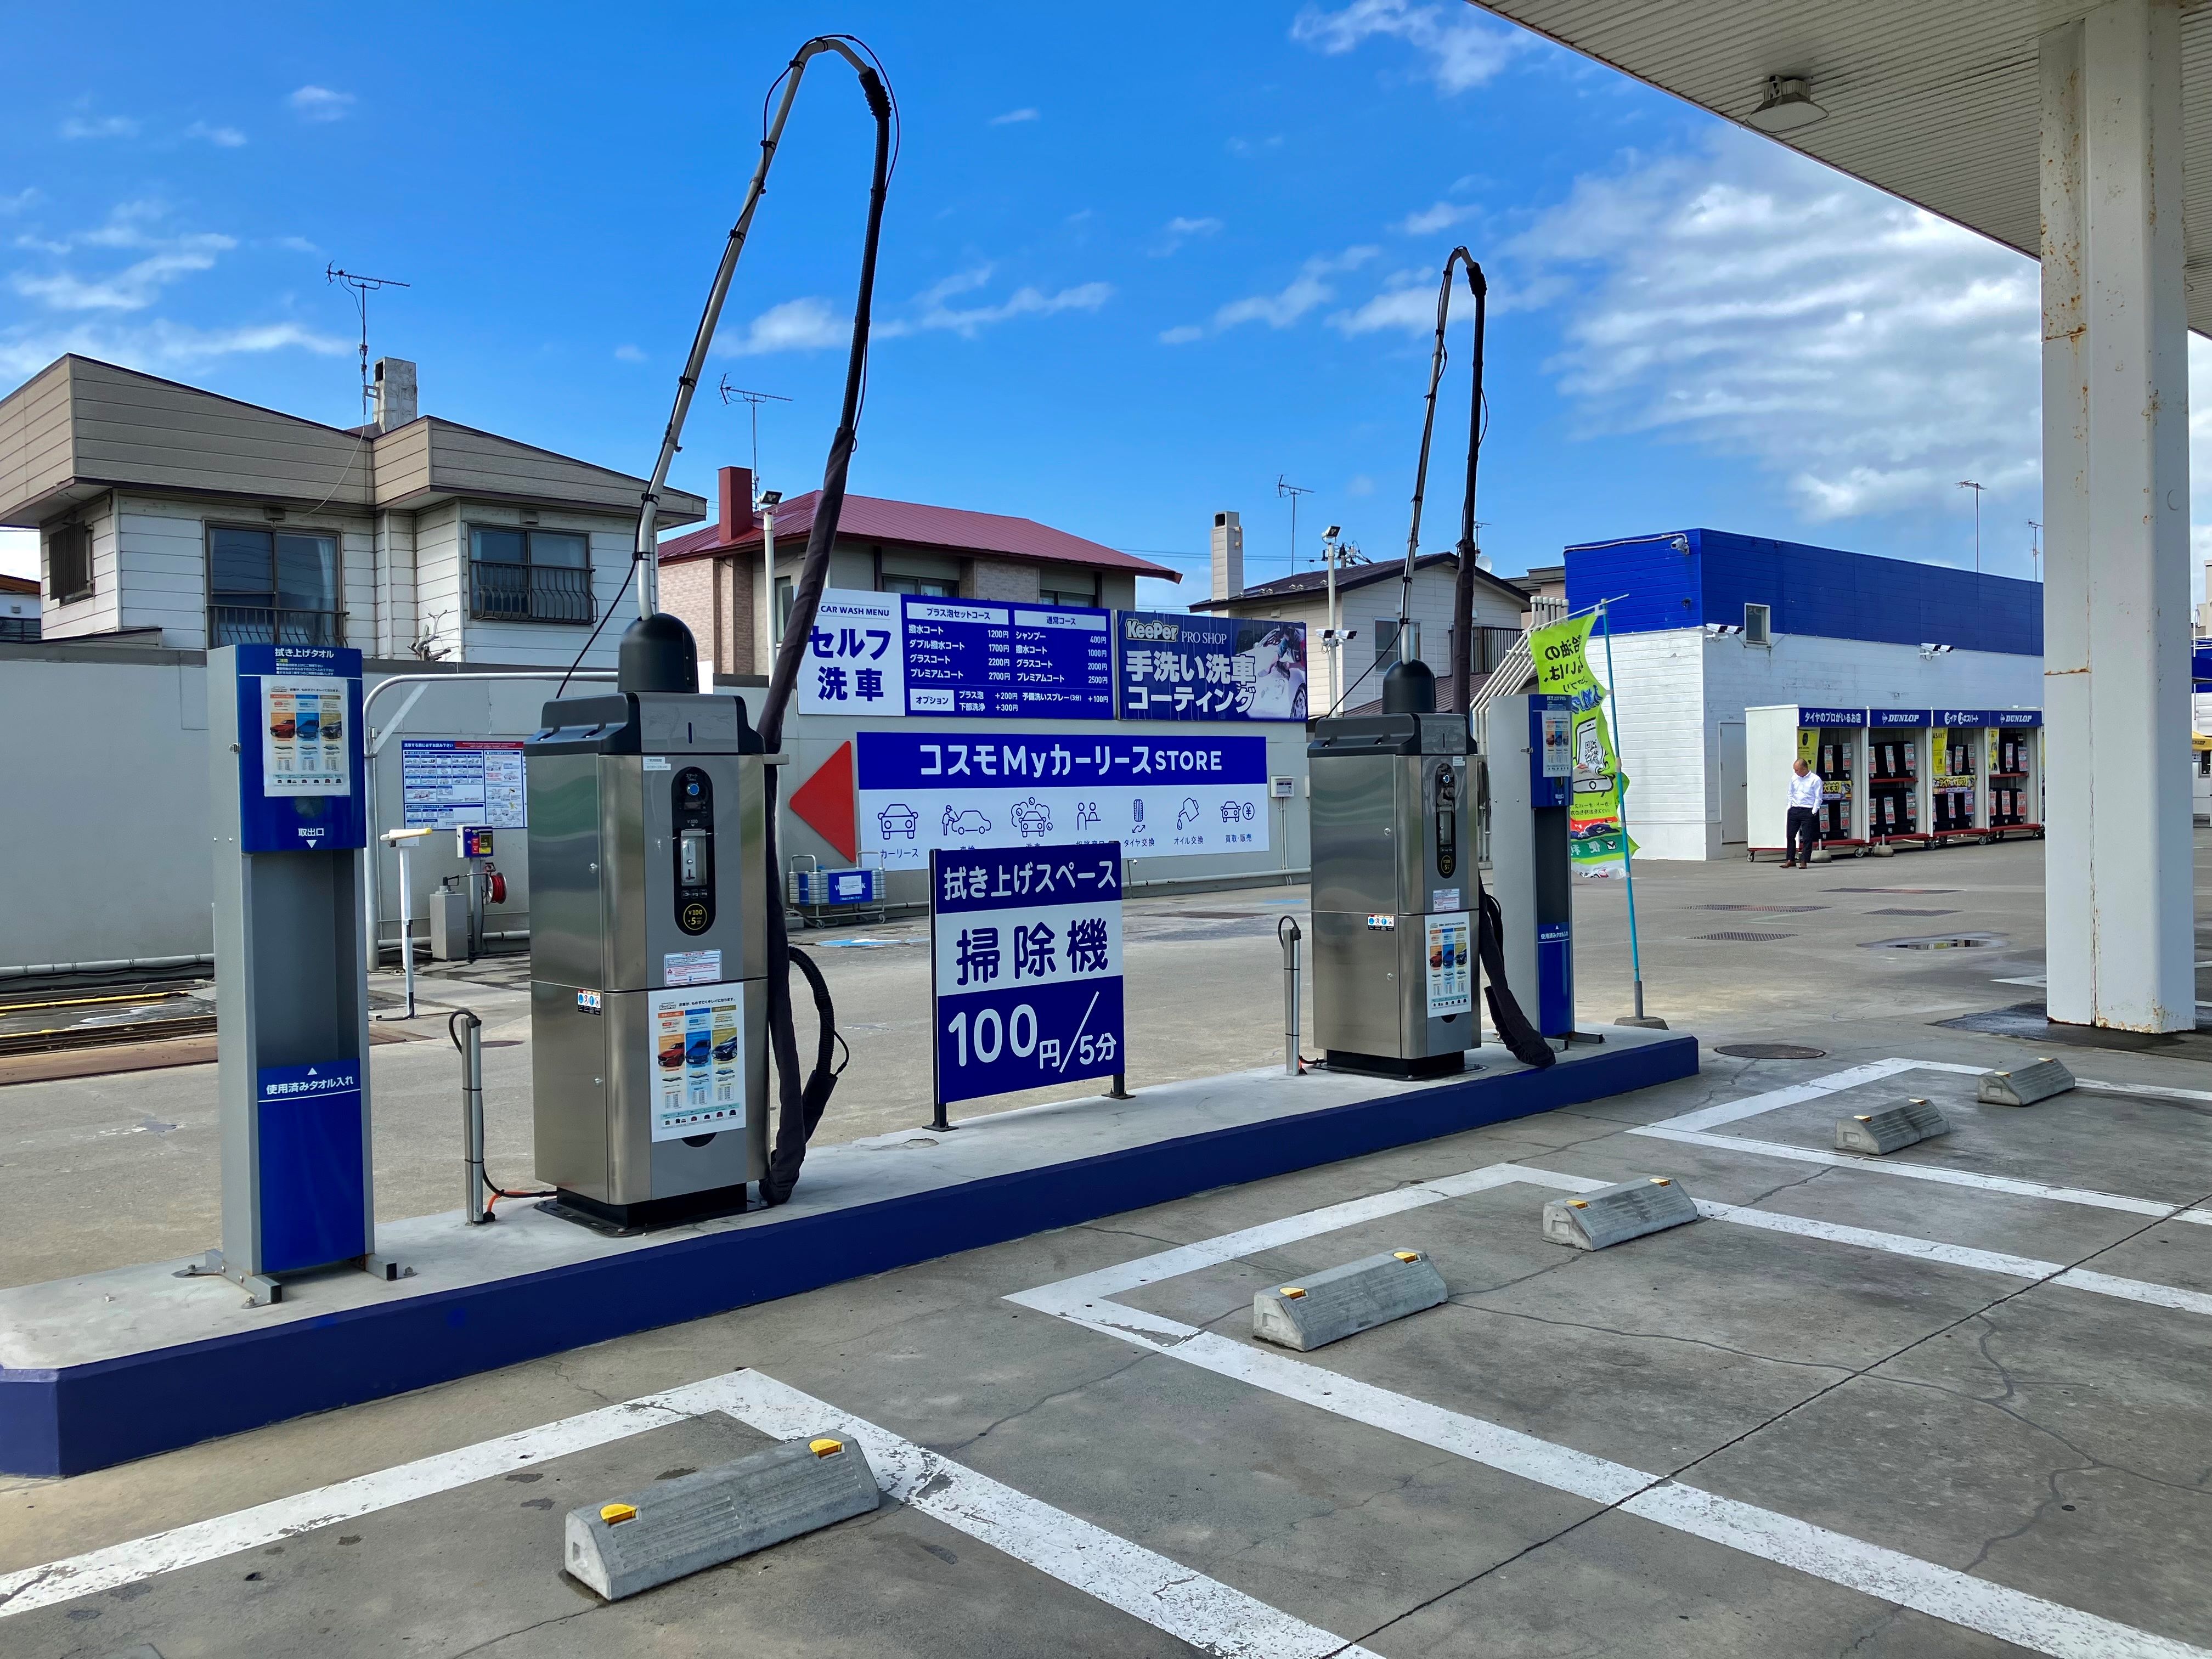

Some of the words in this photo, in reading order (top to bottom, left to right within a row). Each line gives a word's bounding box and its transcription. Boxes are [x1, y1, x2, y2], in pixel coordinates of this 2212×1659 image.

[821, 605, 837, 613] CAR
[839, 607, 864, 615] WASH
[866, 608, 890, 617] MENU
[927, 608, 990, 620] プラス泡セットコース
[1046, 616, 1076, 625] 通常コース
[909, 624, 944, 635] 撥水コート
[988, 629, 1009, 639] 1200円
[1015, 631, 1046, 640] シャンプー
[1090, 636, 1107, 644] 400円
[1126, 620, 1178, 641] KeePer
[1181, 631, 1201, 644] PRO
[1202, 632, 1227, 645] SHOP
[808, 625, 891, 661] セルフ
[909, 639, 965, 651] ダブル撥水コート
[989, 644, 1009, 652] 1700円
[275, 647, 335, 658] 拭き上げタオル
[1016, 645, 1047, 655] 撥水コート
[1088, 649, 1107, 658] 1000円
[910, 654, 950, 664] グラスコート
[988, 658, 1010, 667] 2200円
[1017, 659, 1053, 669] グラスコート
[1087, 663, 1107, 671] 2000円
[1126, 650, 1256, 684] 手洗い洗車
[911, 668, 963, 679] プレミアムコート
[989, 672, 1011, 680] 2700円
[1017, 673, 1065, 683] プレミアムコート
[1088, 676, 1108, 684] 2500円
[817, 665, 884, 702] 洗車
[916, 696, 949, 705] オプション
[959, 690, 984, 699] プラス泡
[1128, 684, 1256, 713] コーティング
[959, 702, 985, 712] 下部洗浄
[1805, 712, 1861, 724] タイヤのプロがいるお店
[1888, 714, 1919, 723] DUNLOP
[298, 828, 324, 837] 取出口
[1225, 833, 1252, 843] 買取・販売
[1124, 838, 1155, 848] タイヤ交換
[1174, 836, 1204, 845] オイル交換
[880, 848, 918, 859] カーリース
[944, 861, 1116, 901] 拭き上げスペース
[956, 917, 1109, 986] 掃除機
[266, 1076, 354, 1095] 使用済みタオル入れ
